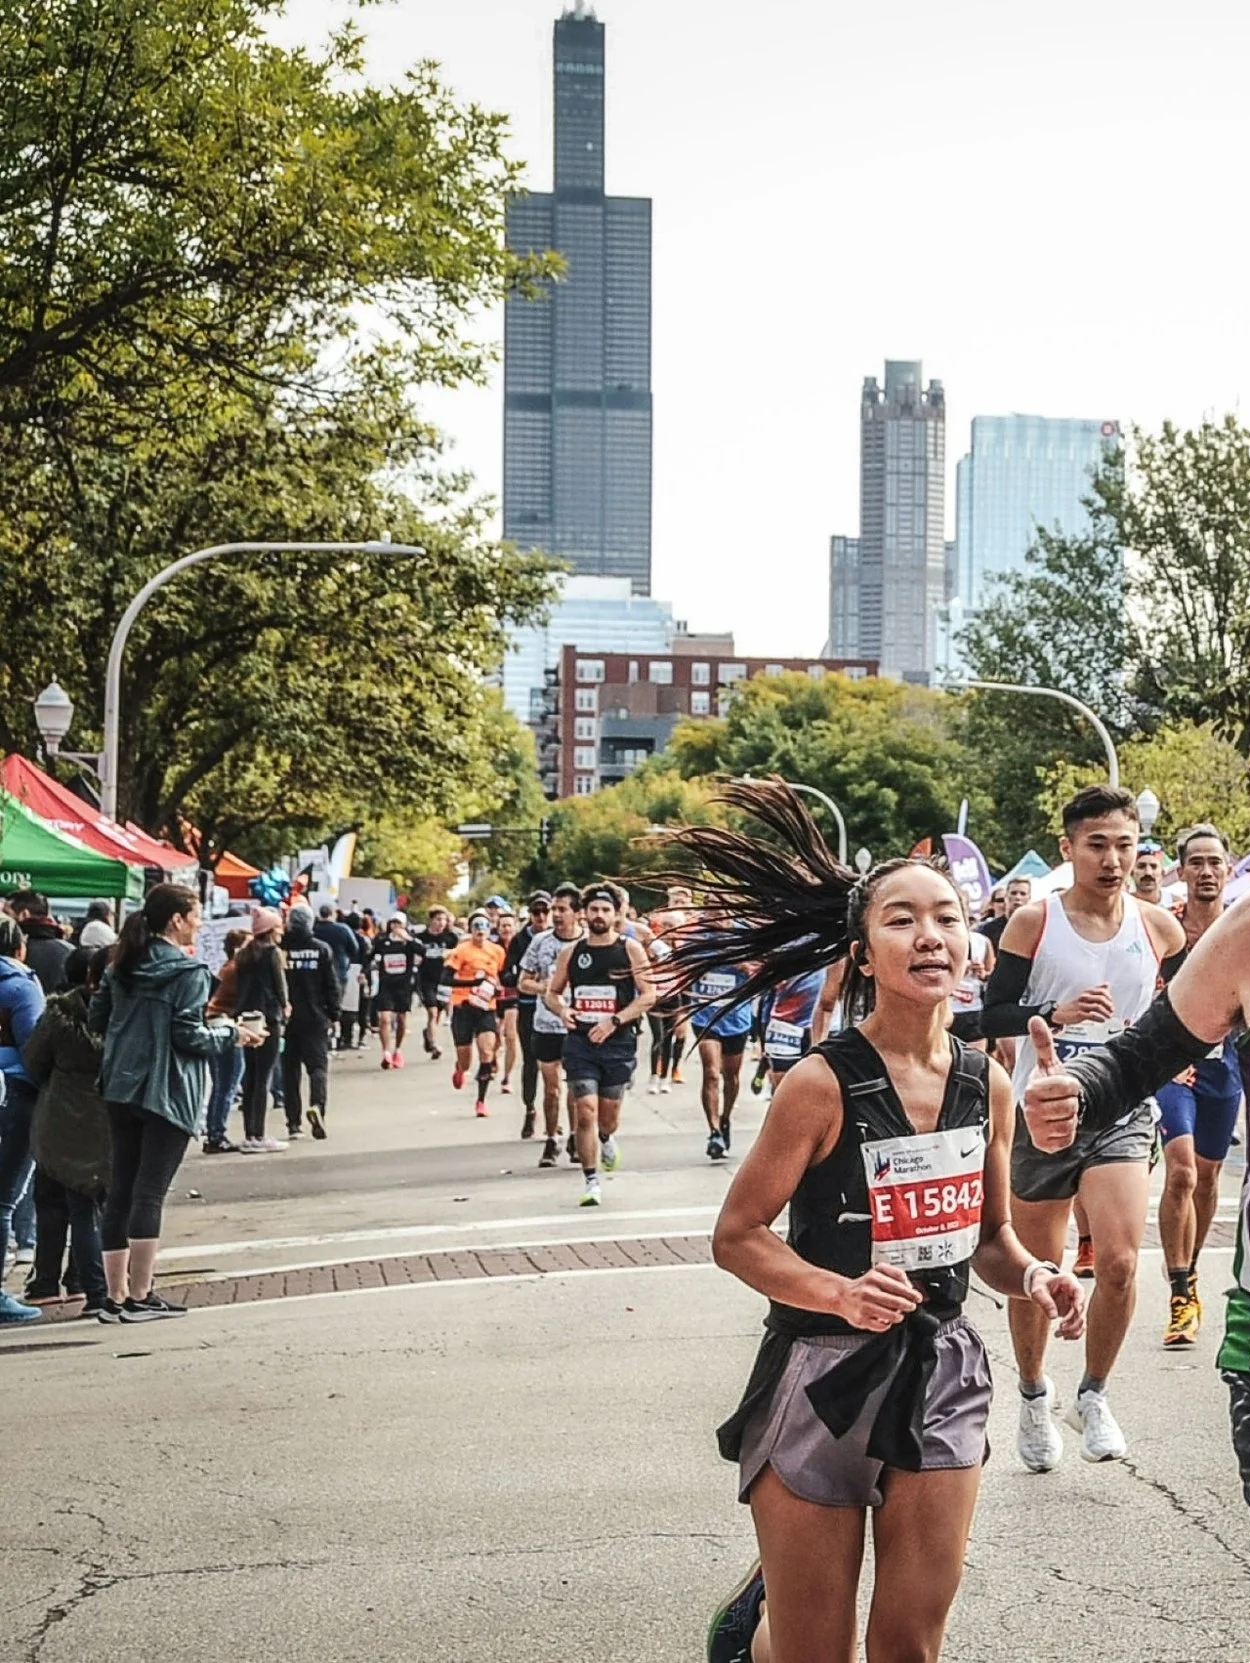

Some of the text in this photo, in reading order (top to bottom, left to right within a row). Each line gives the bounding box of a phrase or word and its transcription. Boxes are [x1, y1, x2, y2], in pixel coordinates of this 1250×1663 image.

[893, 1156, 924, 1166] Chicago
[894, 1164, 932, 1174] Marathon
[874, 1179, 983, 1224] E 15842
[915, 1224, 939, 1235] October
